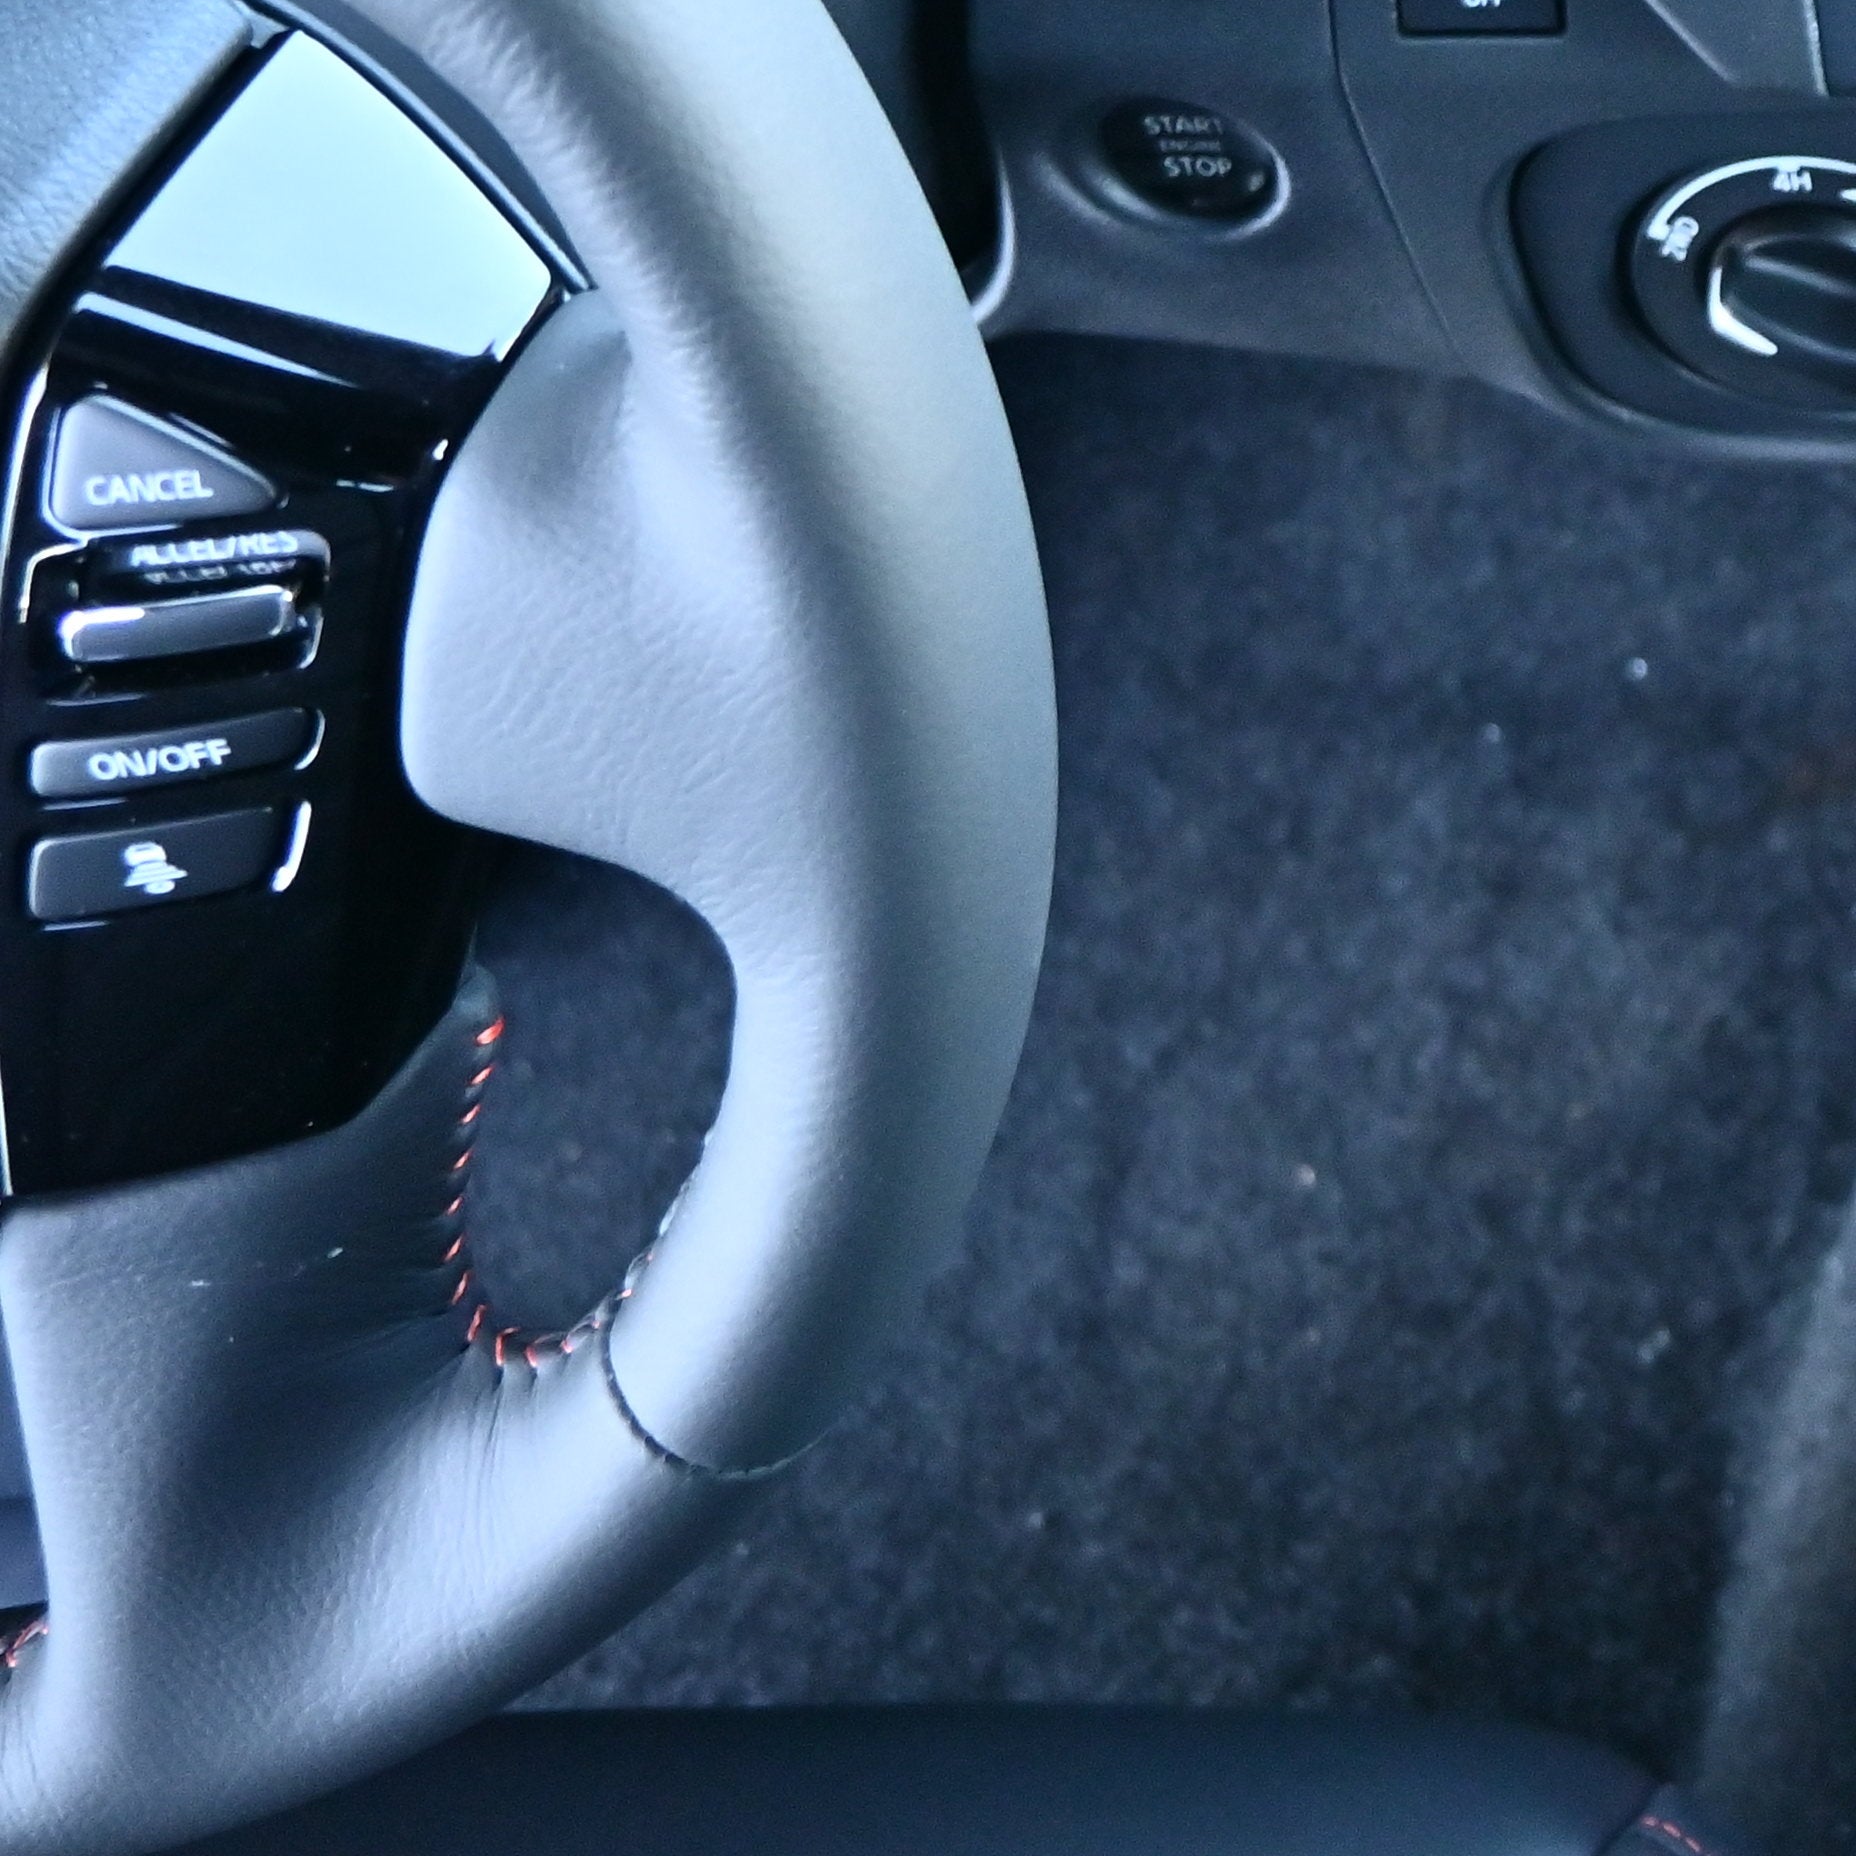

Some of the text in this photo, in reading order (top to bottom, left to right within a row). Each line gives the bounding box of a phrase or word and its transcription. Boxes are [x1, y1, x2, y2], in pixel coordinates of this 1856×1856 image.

[1163, 156, 1232, 177] STOP
[86, 470, 214, 505] CANCEL
[88, 738, 232, 781] ON/OFF
